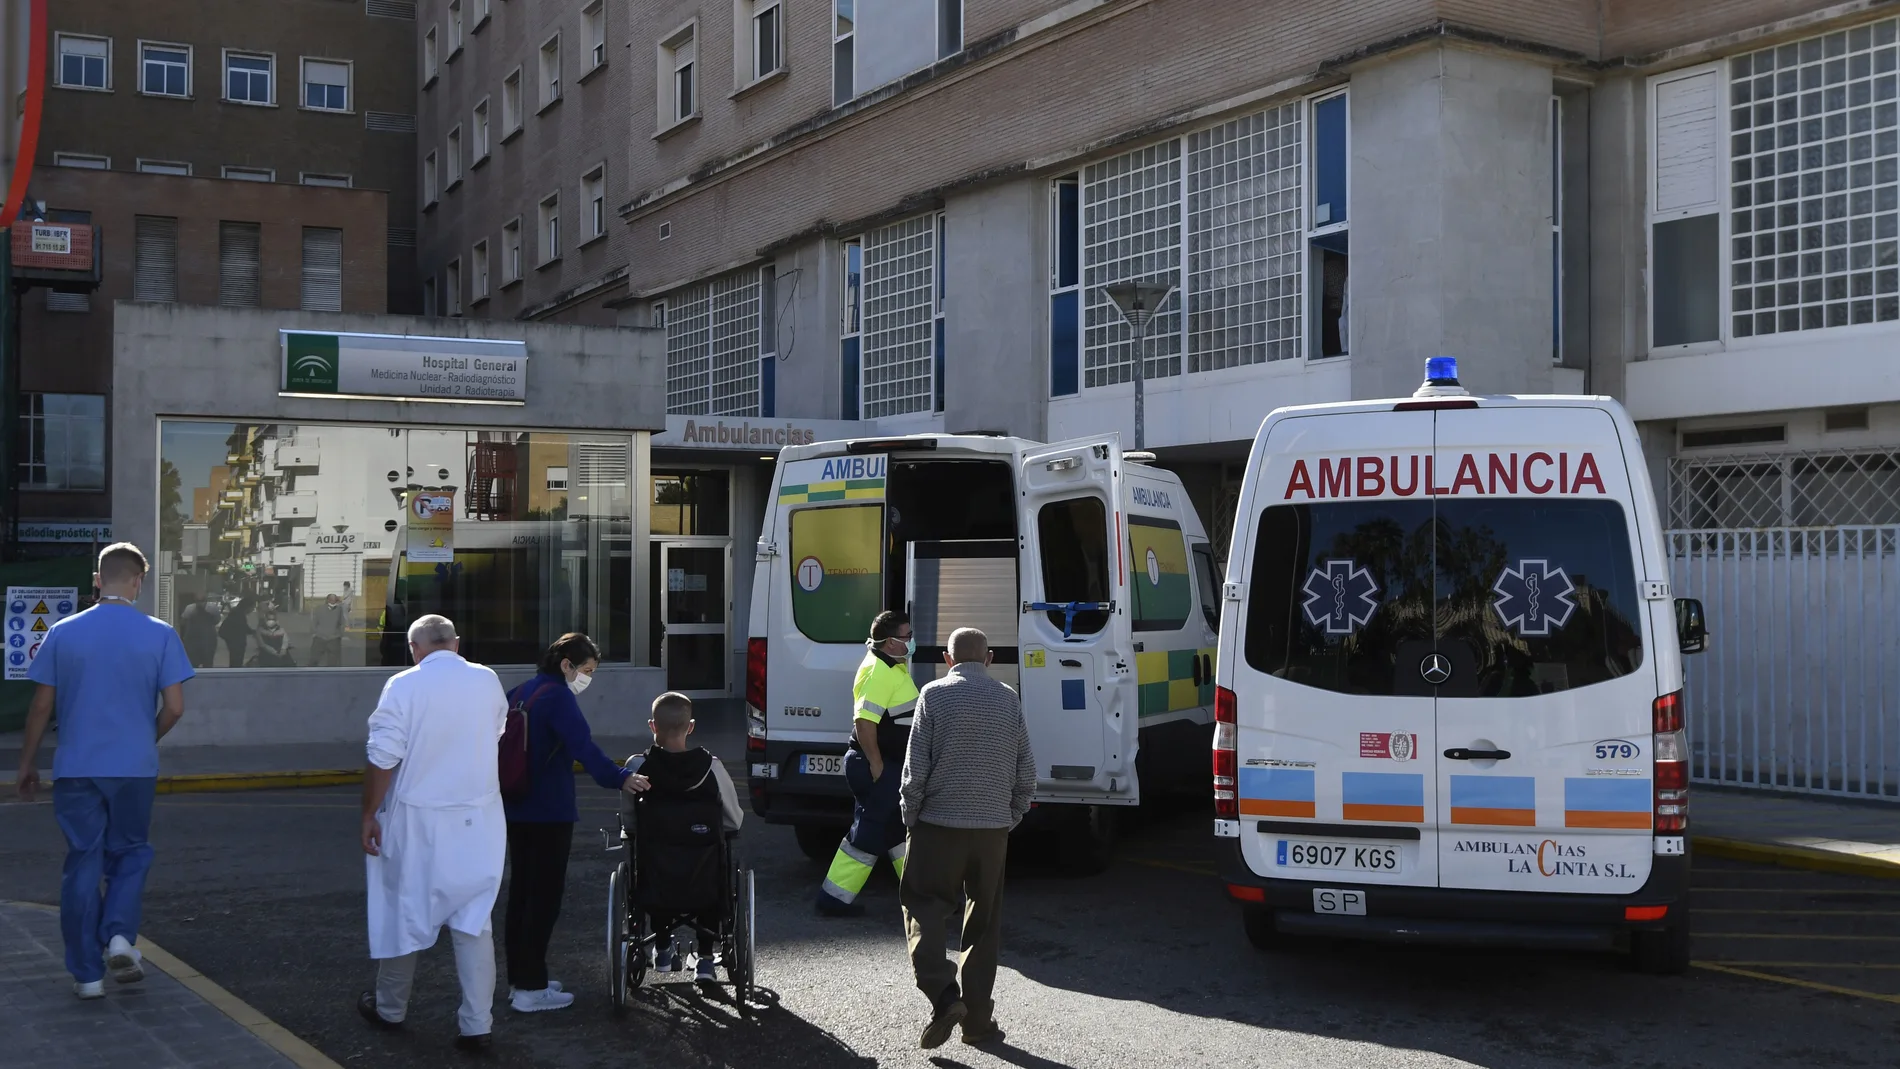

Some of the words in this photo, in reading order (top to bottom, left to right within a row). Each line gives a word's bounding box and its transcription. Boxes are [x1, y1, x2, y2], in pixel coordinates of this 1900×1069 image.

[422, 355, 468, 371] Hospital
[473, 358, 517, 372] General
[370, 368, 408, 380] Medicina
[410, 370, 442, 382] Nuclear
[448, 371, 516, 386] Radiodiagnóstico
[420, 383, 451, 395] Unidad
[454, 385, 461, 394] 2
[465, 385, 515, 398] Radioterapia
[683, 419, 815, 445] Ambulancias
[1284, 451, 1607, 500] AMBULANCIA
[1132, 486, 1173, 509] AMBULANCIA
[803, 565, 818, 587] T
[784, 706, 822, 717] IVECO
[1596, 745, 1632, 759] 579
[808, 757, 841, 773] 5505
[1292, 844, 1347, 867] 6907
[1355, 848, 1396, 870] KGS
[1454, 839, 1587, 866] AMBULANCIAS
[1508, 858, 1533, 874] LA
[1604, 863, 1636, 879] S.L.
